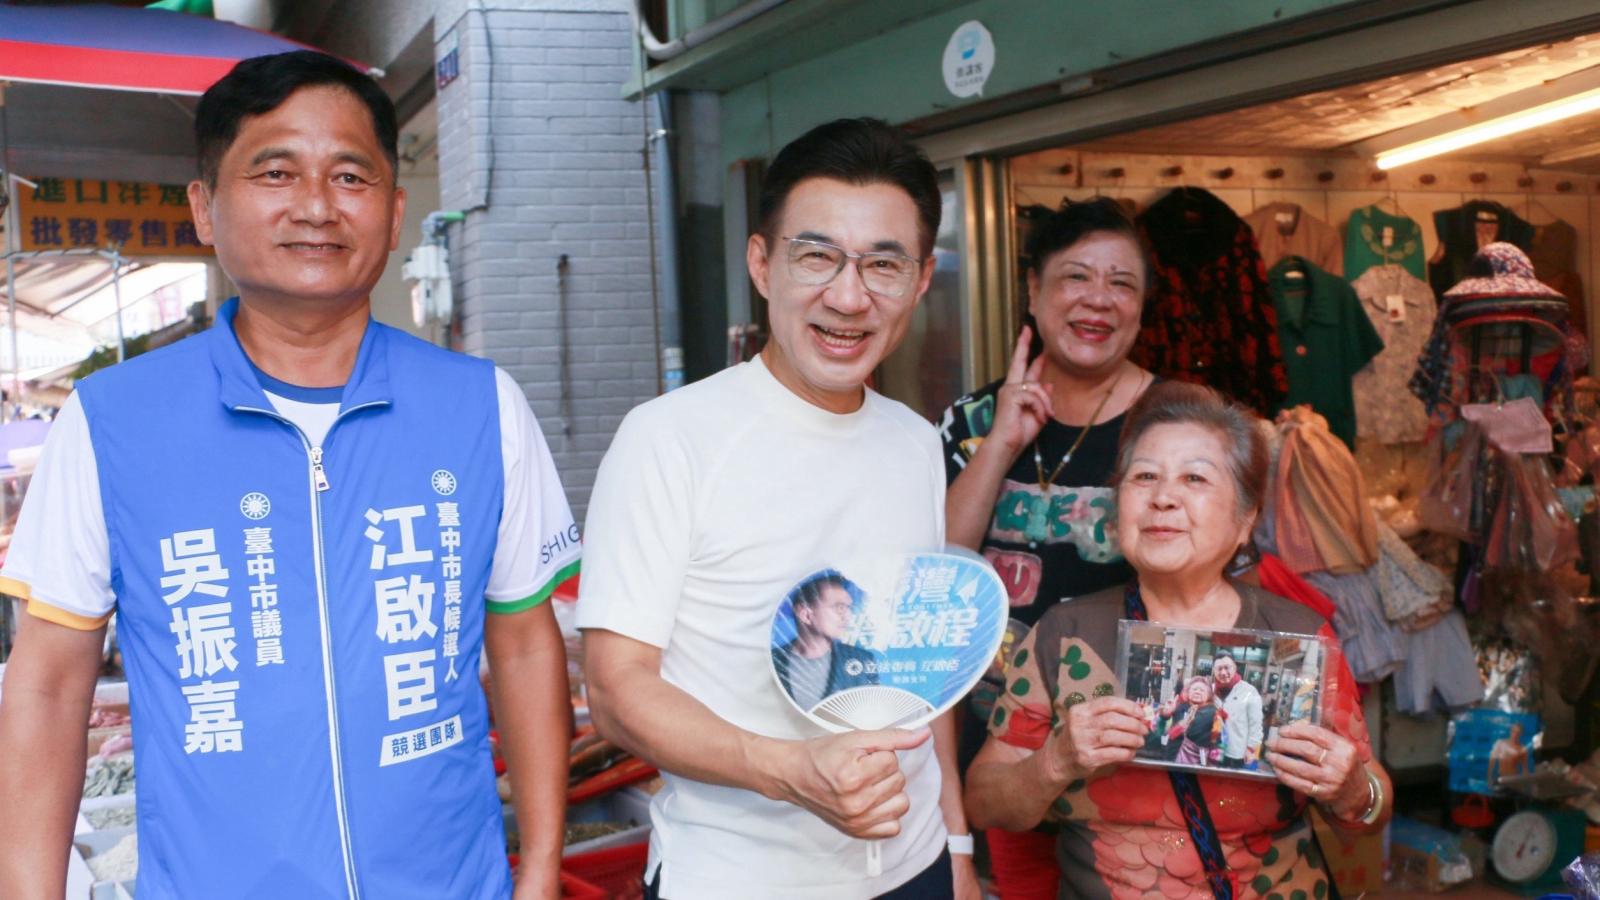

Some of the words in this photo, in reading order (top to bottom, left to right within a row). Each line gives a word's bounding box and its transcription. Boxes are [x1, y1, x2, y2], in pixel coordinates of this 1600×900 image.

[160, 528, 244, 754] 吳振嘉
[243, 527, 285, 667] 臺中市議員
[364, 504, 439, 721] 江啟臣
[436, 502, 461, 683] 臺中市長候選人
[391, 721, 457, 758] 競選團隊
